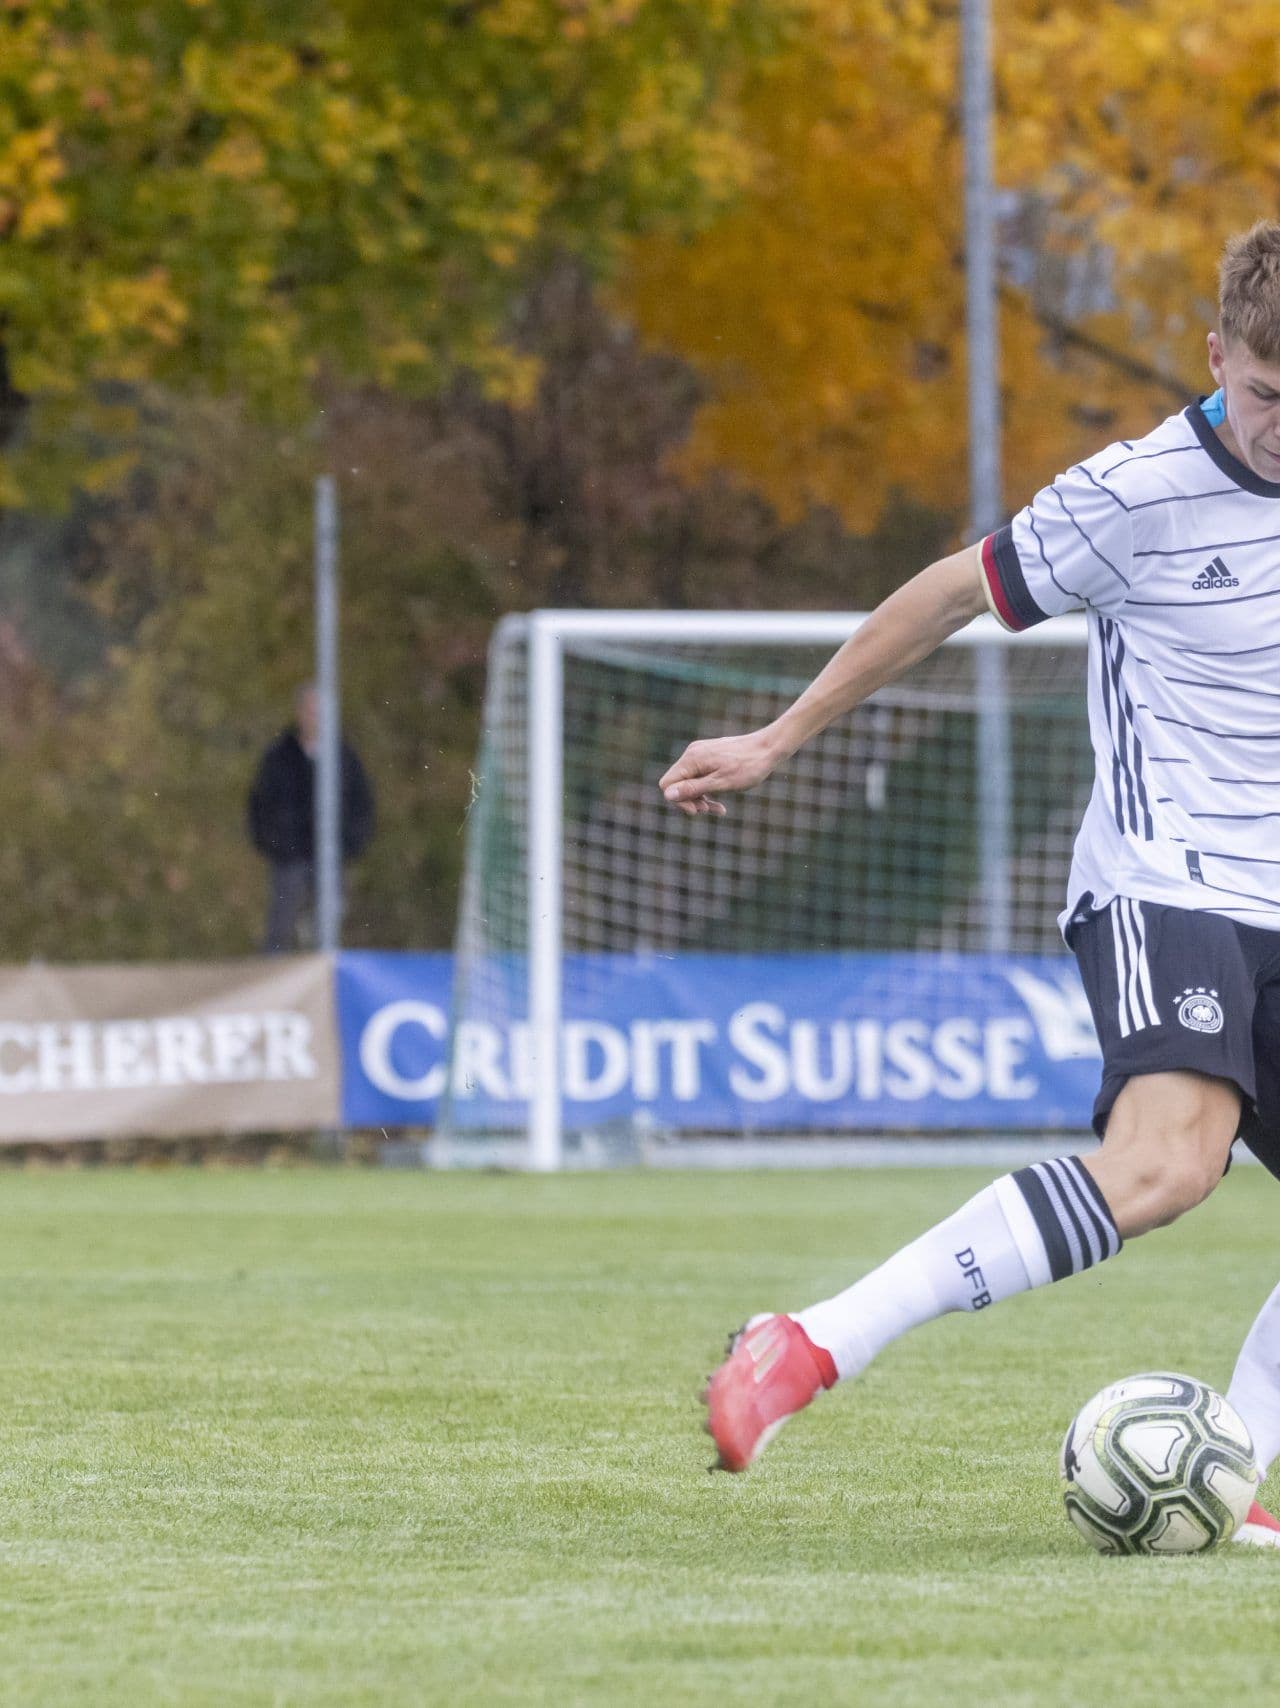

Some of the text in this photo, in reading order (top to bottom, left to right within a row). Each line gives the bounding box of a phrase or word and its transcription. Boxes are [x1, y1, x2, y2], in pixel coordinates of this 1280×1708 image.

[1192, 575, 1240, 590] adidas
[729, 1002, 1038, 1100] SUISSE
[955, 1247, 992, 1310] DFB
